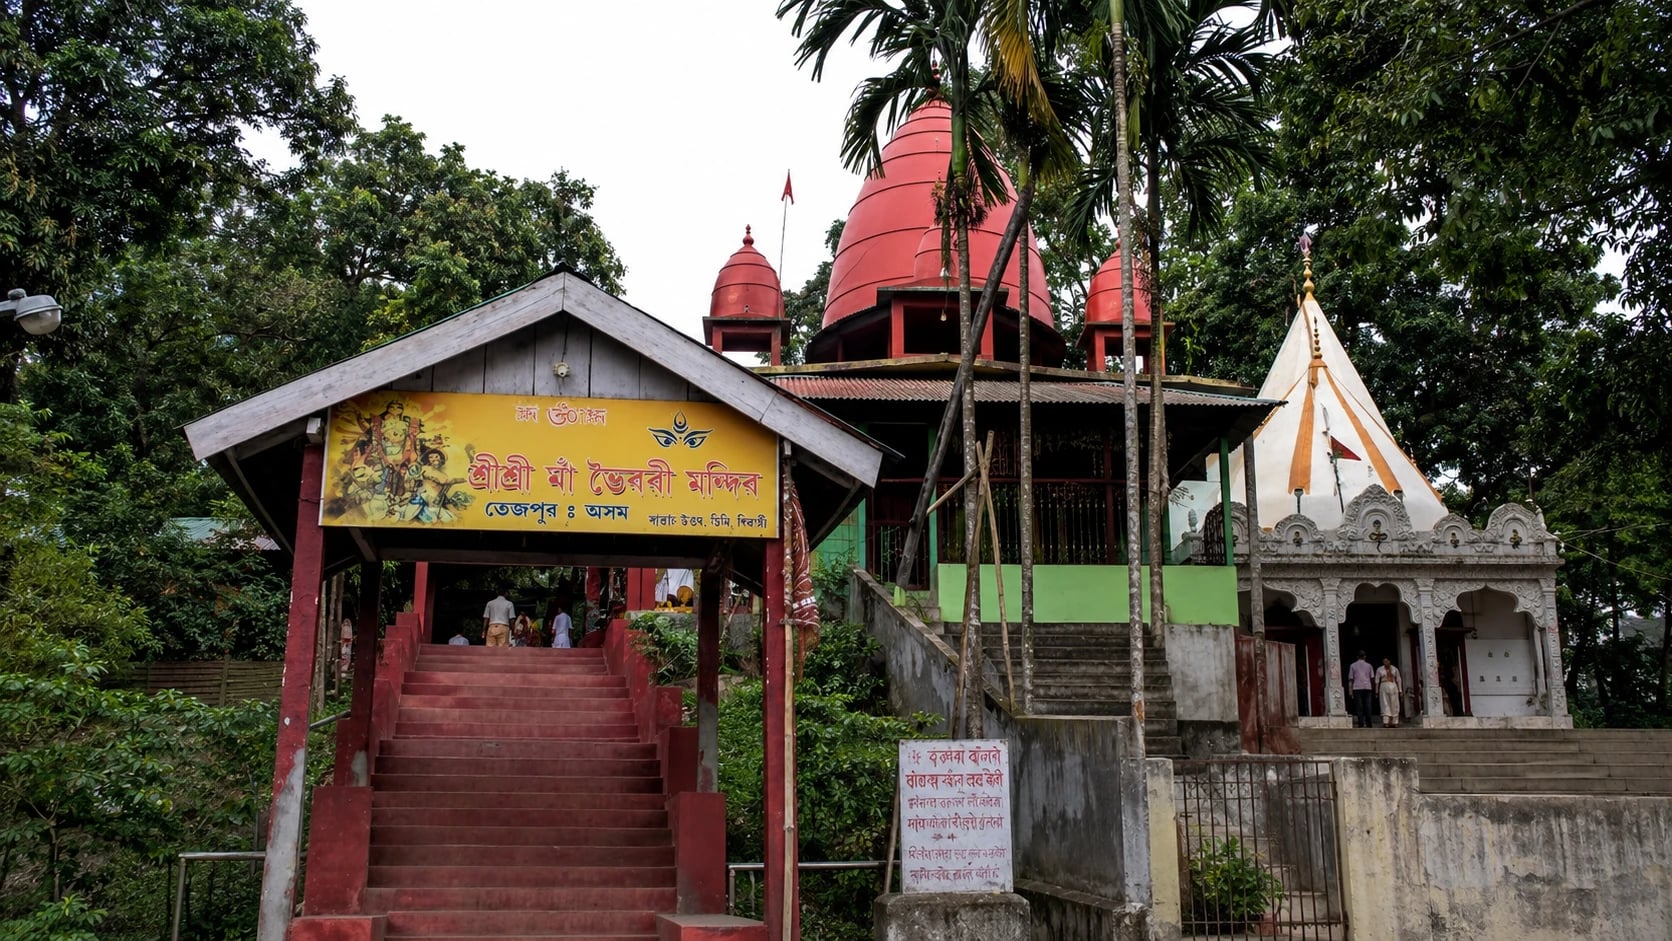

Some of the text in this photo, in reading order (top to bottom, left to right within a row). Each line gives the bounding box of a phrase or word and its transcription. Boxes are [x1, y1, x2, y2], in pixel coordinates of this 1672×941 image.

[684, 459, 763, 499] মন্দির
[485, 501, 558, 525] তেজপুর
[584, 504, 629, 521] অসম
